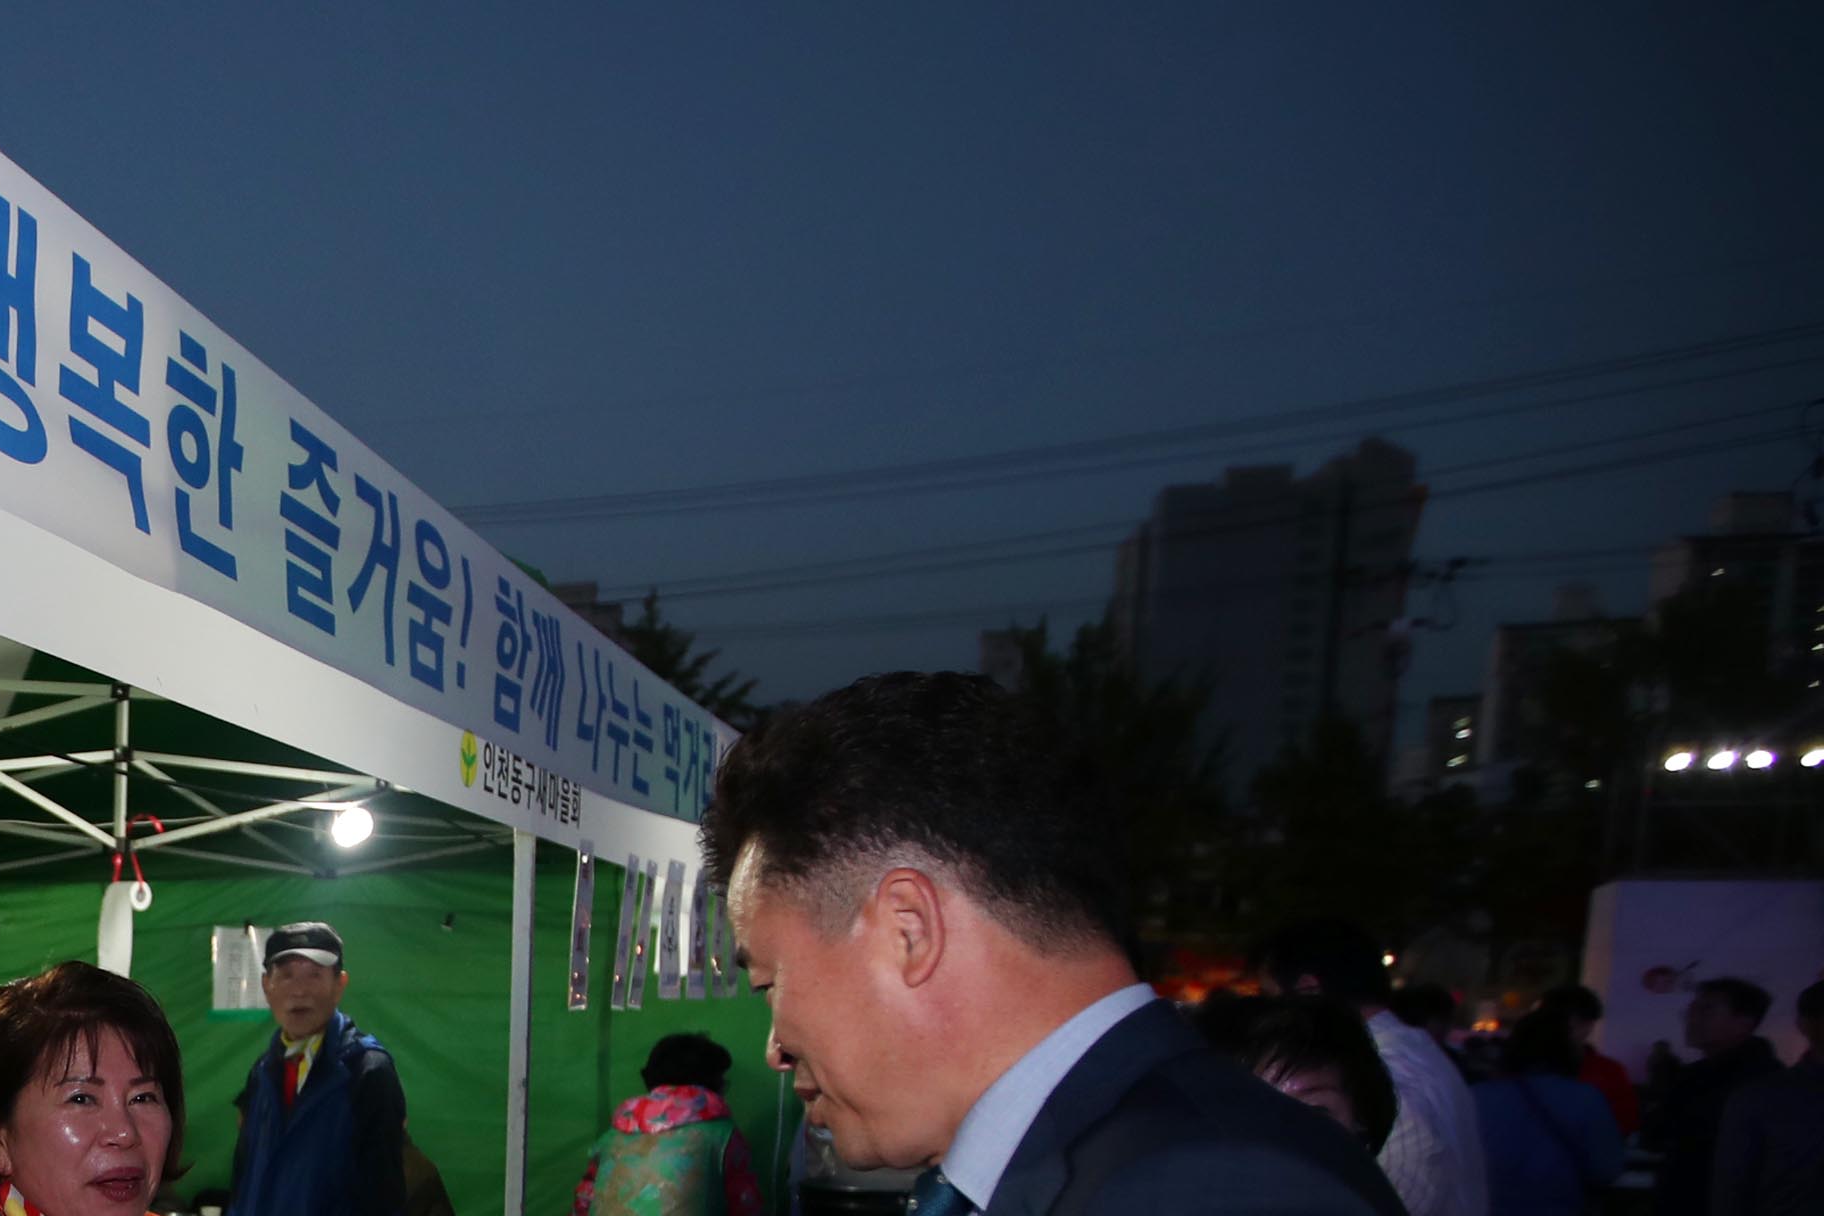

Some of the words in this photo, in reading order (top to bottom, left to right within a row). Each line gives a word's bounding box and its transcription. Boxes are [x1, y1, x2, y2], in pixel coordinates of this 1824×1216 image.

[279, 417, 474, 694] 즐거움!
[494, 575, 566, 752] 함께
[576, 640, 654, 796] 나누는
[483, 741, 582, 829] 인천동구새마을회
